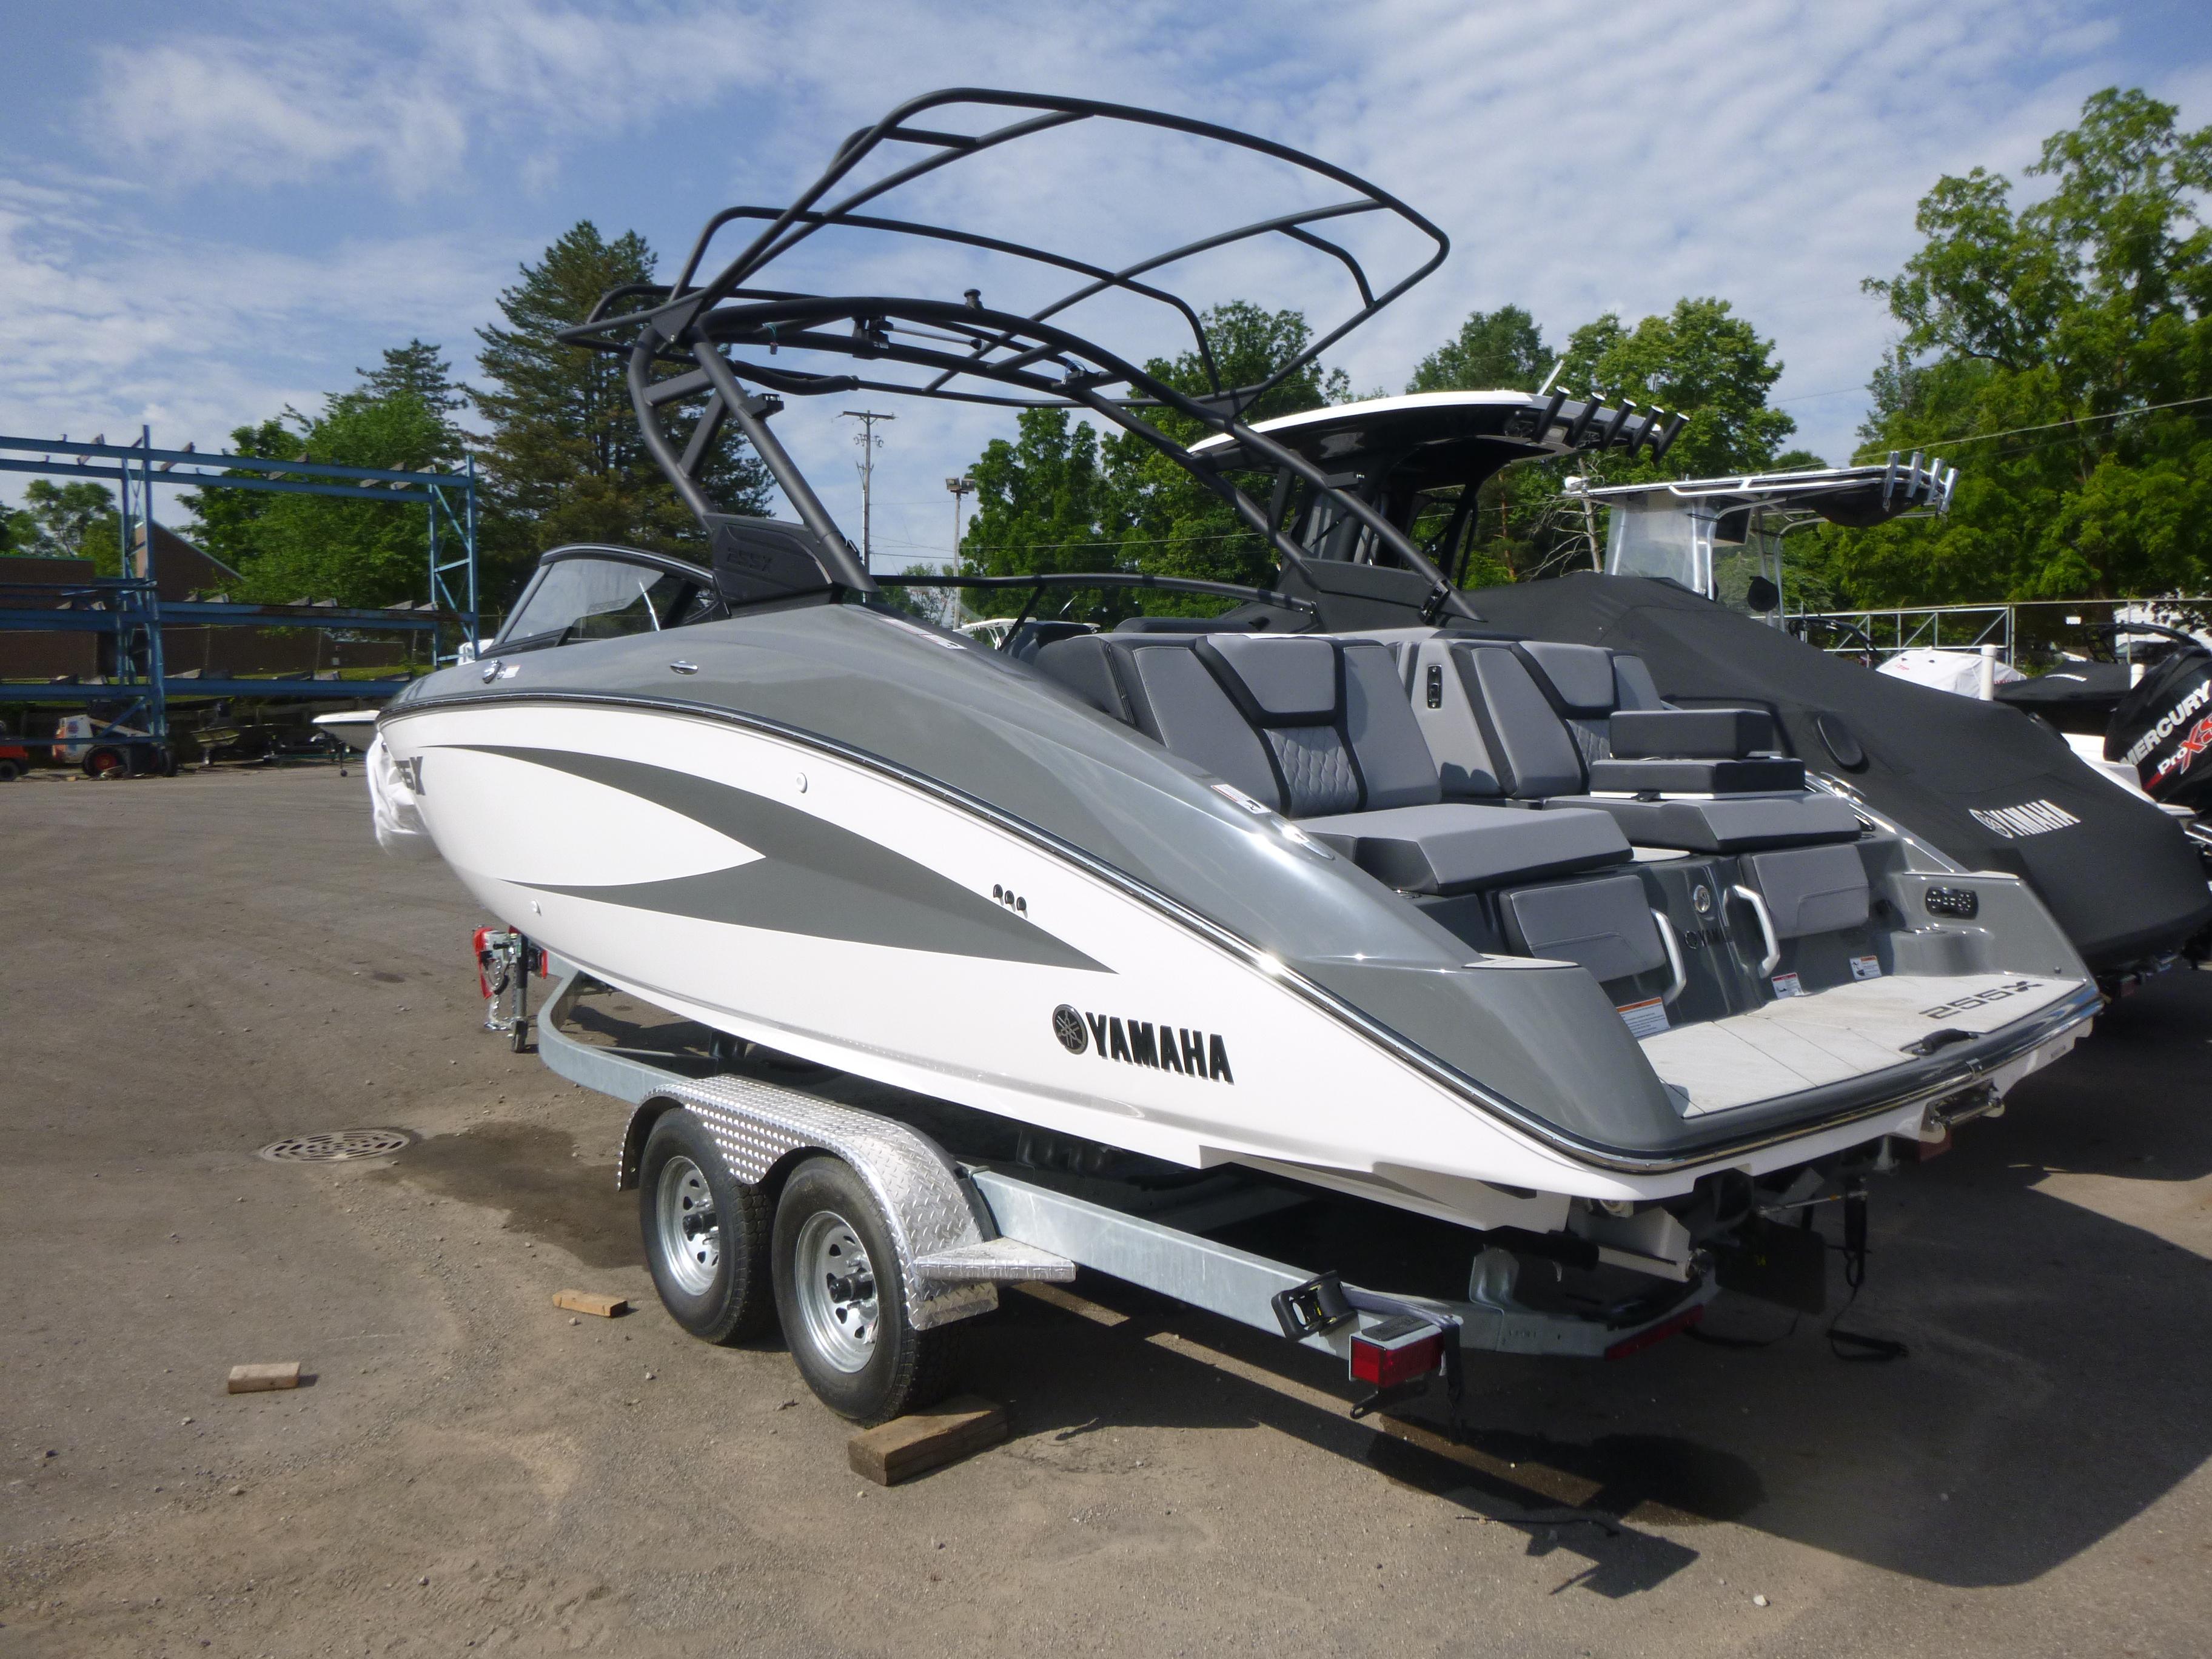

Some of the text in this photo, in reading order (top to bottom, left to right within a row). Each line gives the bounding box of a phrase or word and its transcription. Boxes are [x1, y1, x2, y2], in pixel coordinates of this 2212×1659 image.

[1983, 799, 2081, 836] YAMAHA
[1918, 980, 2044, 1019] 255X
[1085, 1011, 1235, 1085] YAMAHA
